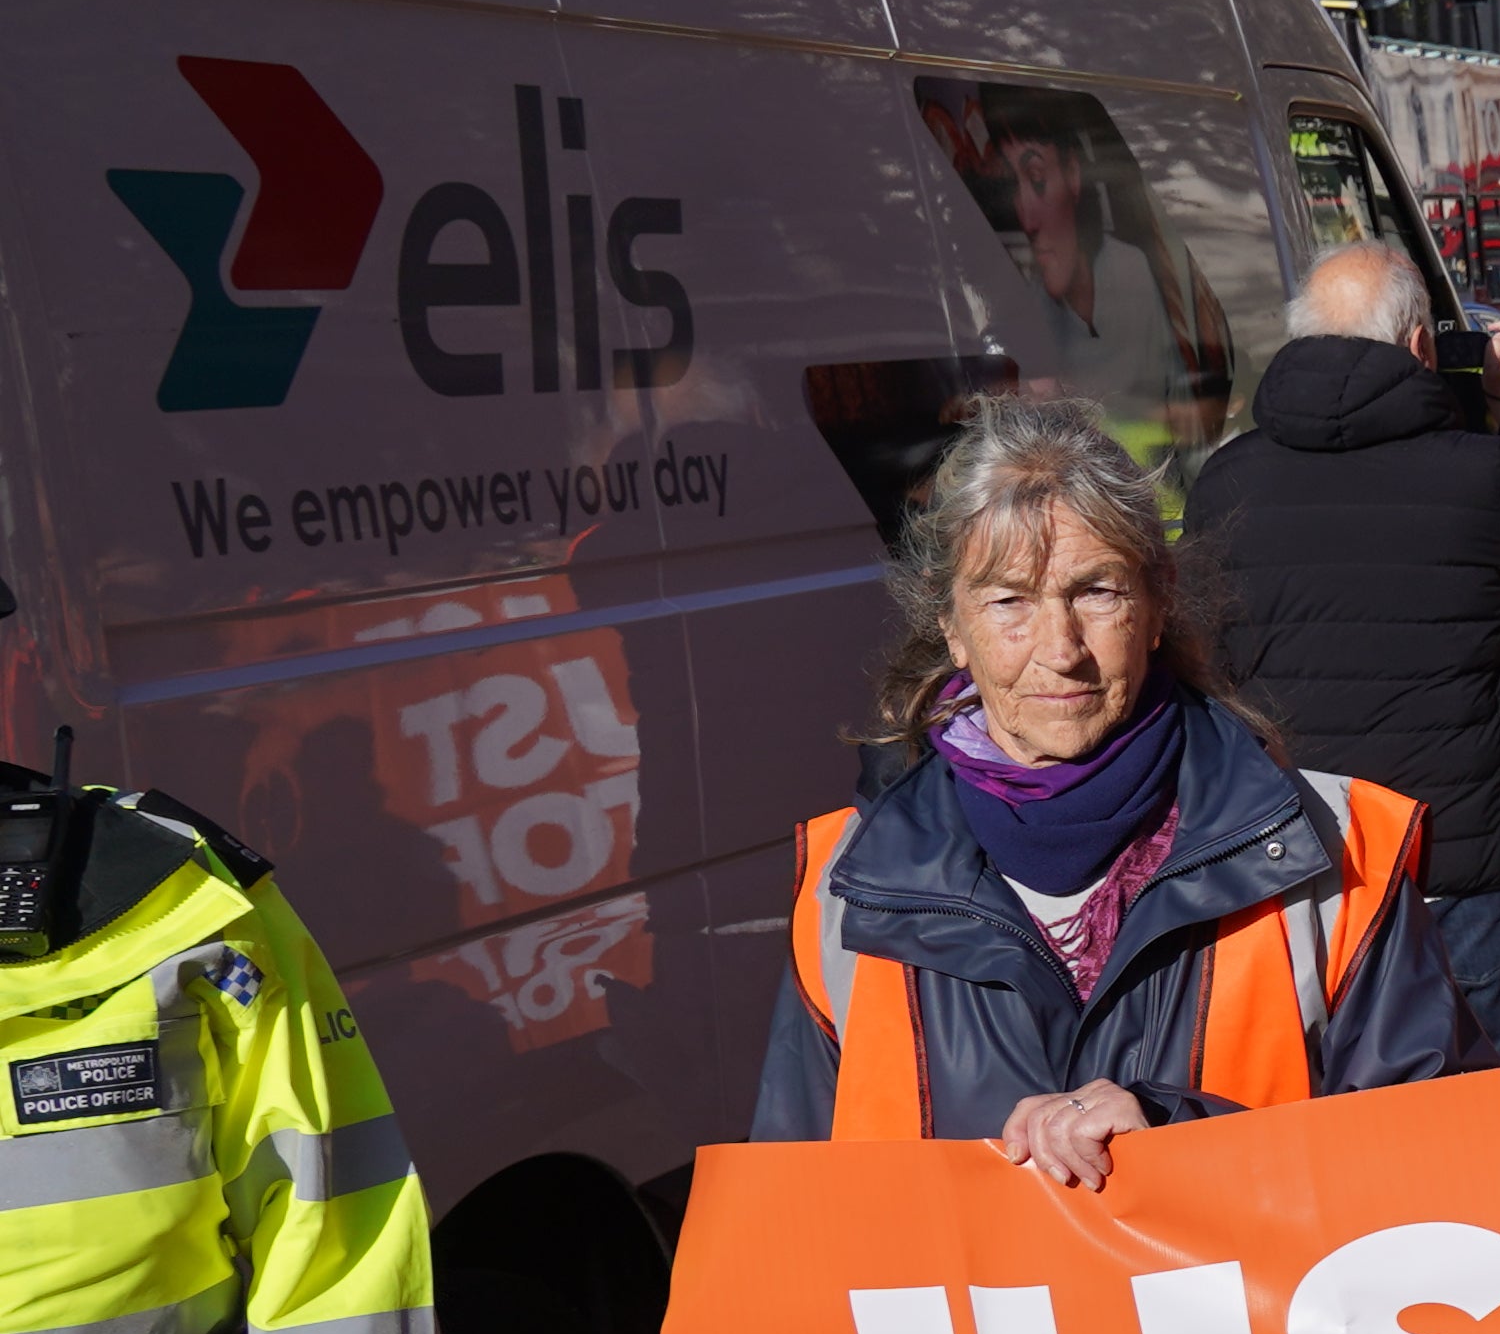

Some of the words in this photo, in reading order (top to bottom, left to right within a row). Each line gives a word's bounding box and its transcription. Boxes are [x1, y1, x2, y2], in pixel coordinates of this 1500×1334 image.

[398, 83, 694, 397] elis
[171, 478, 272, 558] We
[291, 470, 531, 556] empower
[545, 459, 639, 536] your
[655, 440, 728, 516] day
[67, 1054, 145, 1071] METROPOLITAN
[80, 1065, 136, 1084] POLICE
[23, 1094, 89, 1115] POLICE
[91, 1086, 154, 1107] OFFICER
